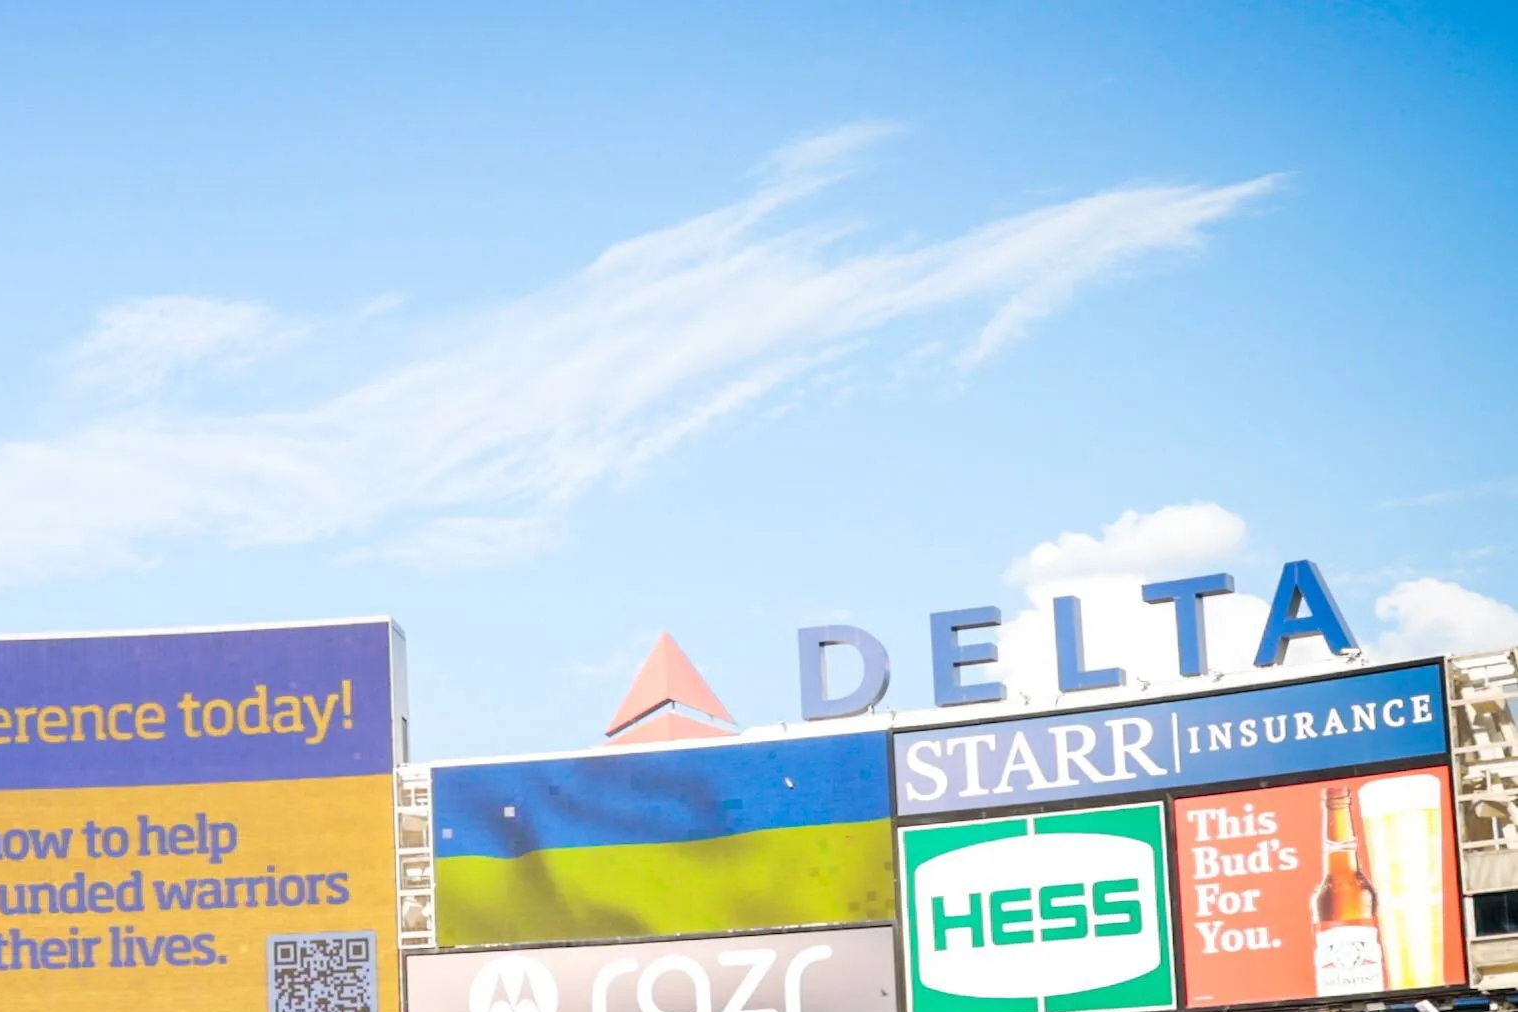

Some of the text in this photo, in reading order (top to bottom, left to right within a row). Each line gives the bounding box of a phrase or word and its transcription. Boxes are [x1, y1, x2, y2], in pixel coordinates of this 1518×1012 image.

[798, 559, 1362, 720] DELTA
[180, 679, 354, 745] today!
[906, 694, 1433, 801] STARR INSURANCE
[82, 820, 128, 859] to
[137, 812, 238, 863] help
[1187, 805, 1278, 843] This
[1192, 841, 1299, 879] Bud's
[152, 866, 349, 911] warriors
[1195, 884, 1260, 918] For
[933, 878, 1142, 951] HESS
[109, 927, 227, 969] lives.
[1195, 922, 1282, 954] You.
